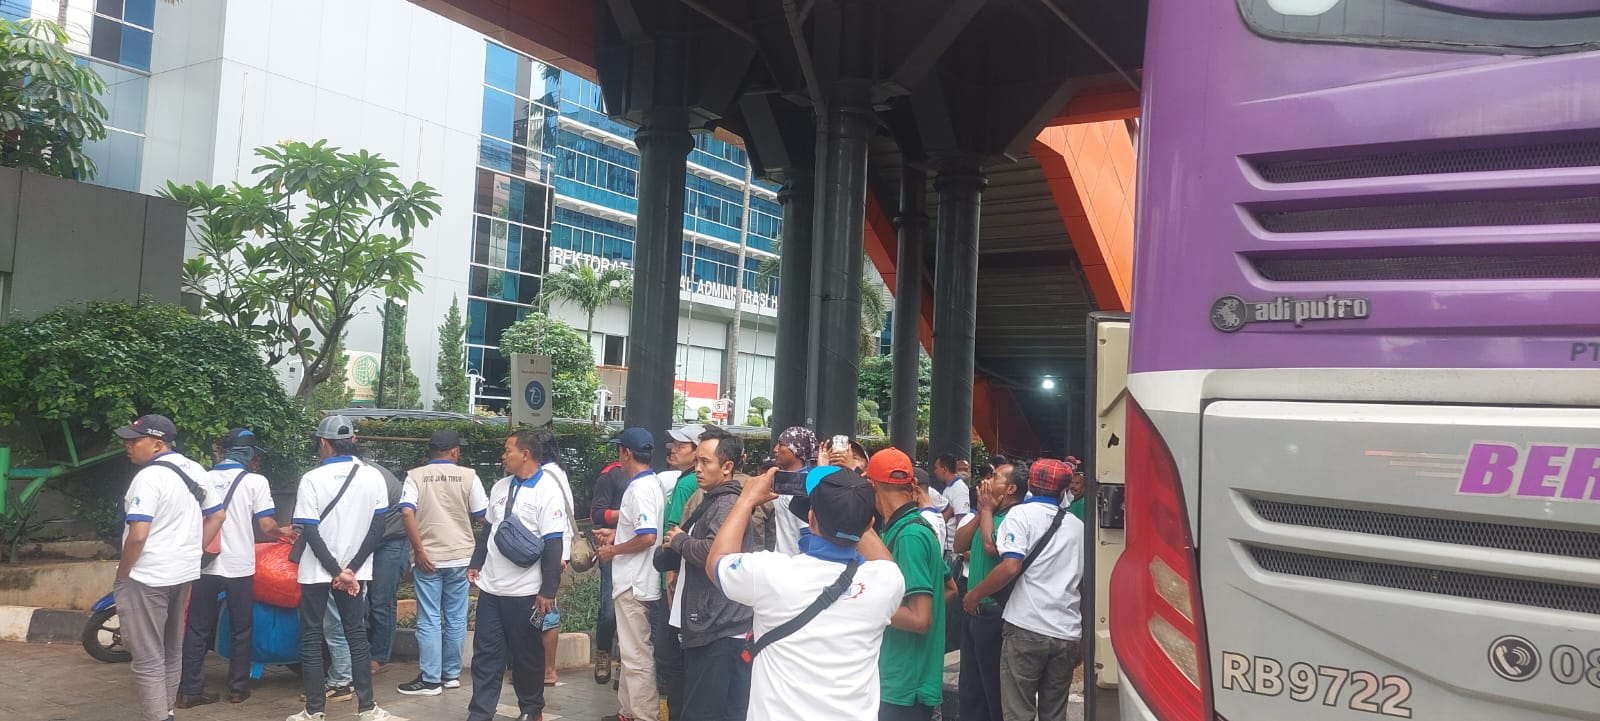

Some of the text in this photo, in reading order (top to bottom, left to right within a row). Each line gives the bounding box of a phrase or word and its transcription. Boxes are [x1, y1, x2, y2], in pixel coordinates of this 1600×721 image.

[1255, 295, 1367, 326] adi putro
[1456, 440, 1600, 501] BER
